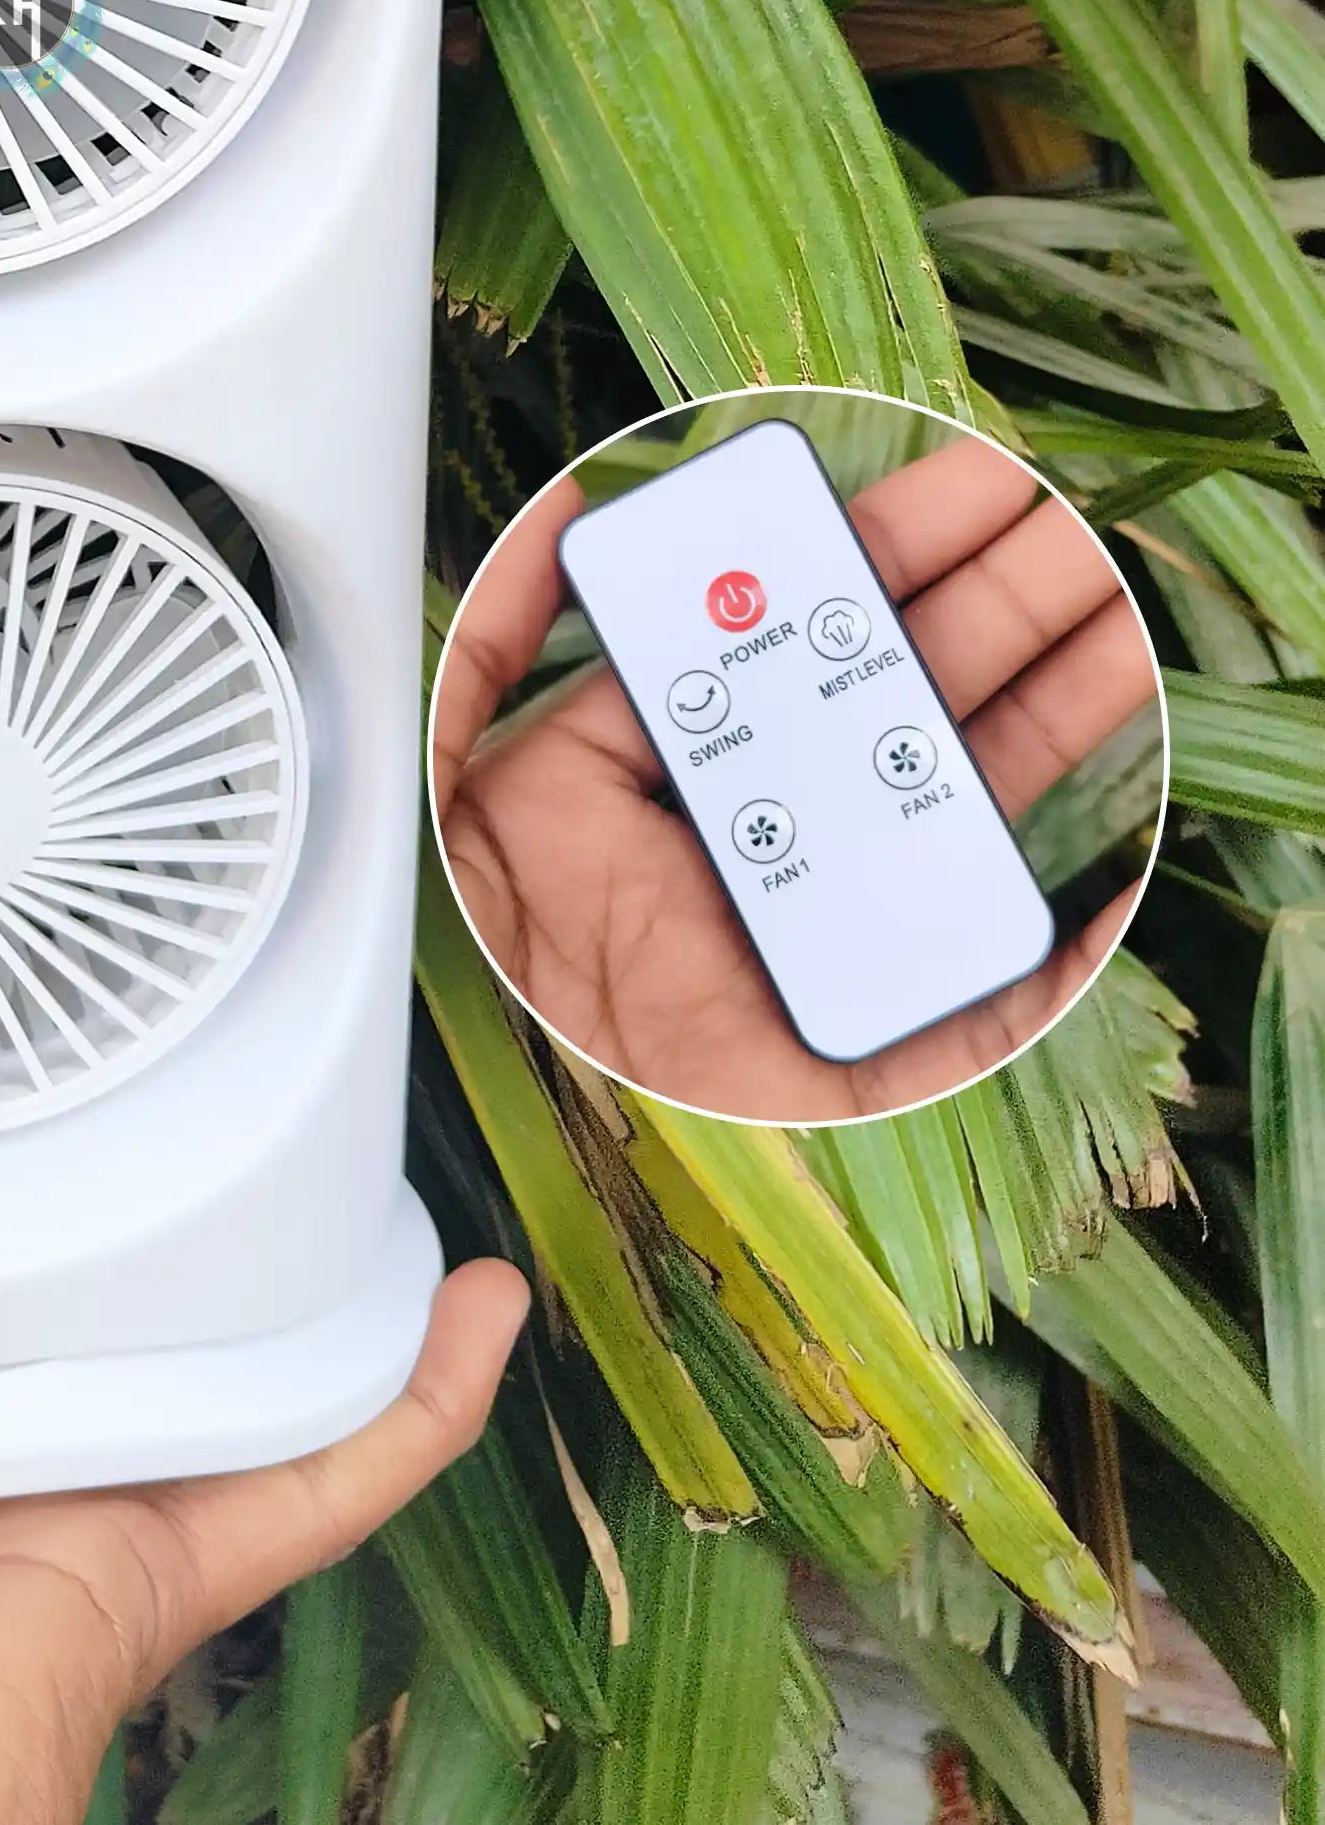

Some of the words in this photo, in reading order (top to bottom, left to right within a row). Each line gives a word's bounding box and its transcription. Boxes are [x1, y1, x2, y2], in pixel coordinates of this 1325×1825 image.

[719, 621, 798, 671] POWER
[818, 669, 855, 700] MIST
[855, 647, 905, 681] LEVEL
[689, 724, 754, 767] SWING
[900, 789, 940, 820] FAN
[940, 782, 955, 799] 2
[761, 862, 800, 893] FAN
[799, 857, 810, 873] 1
